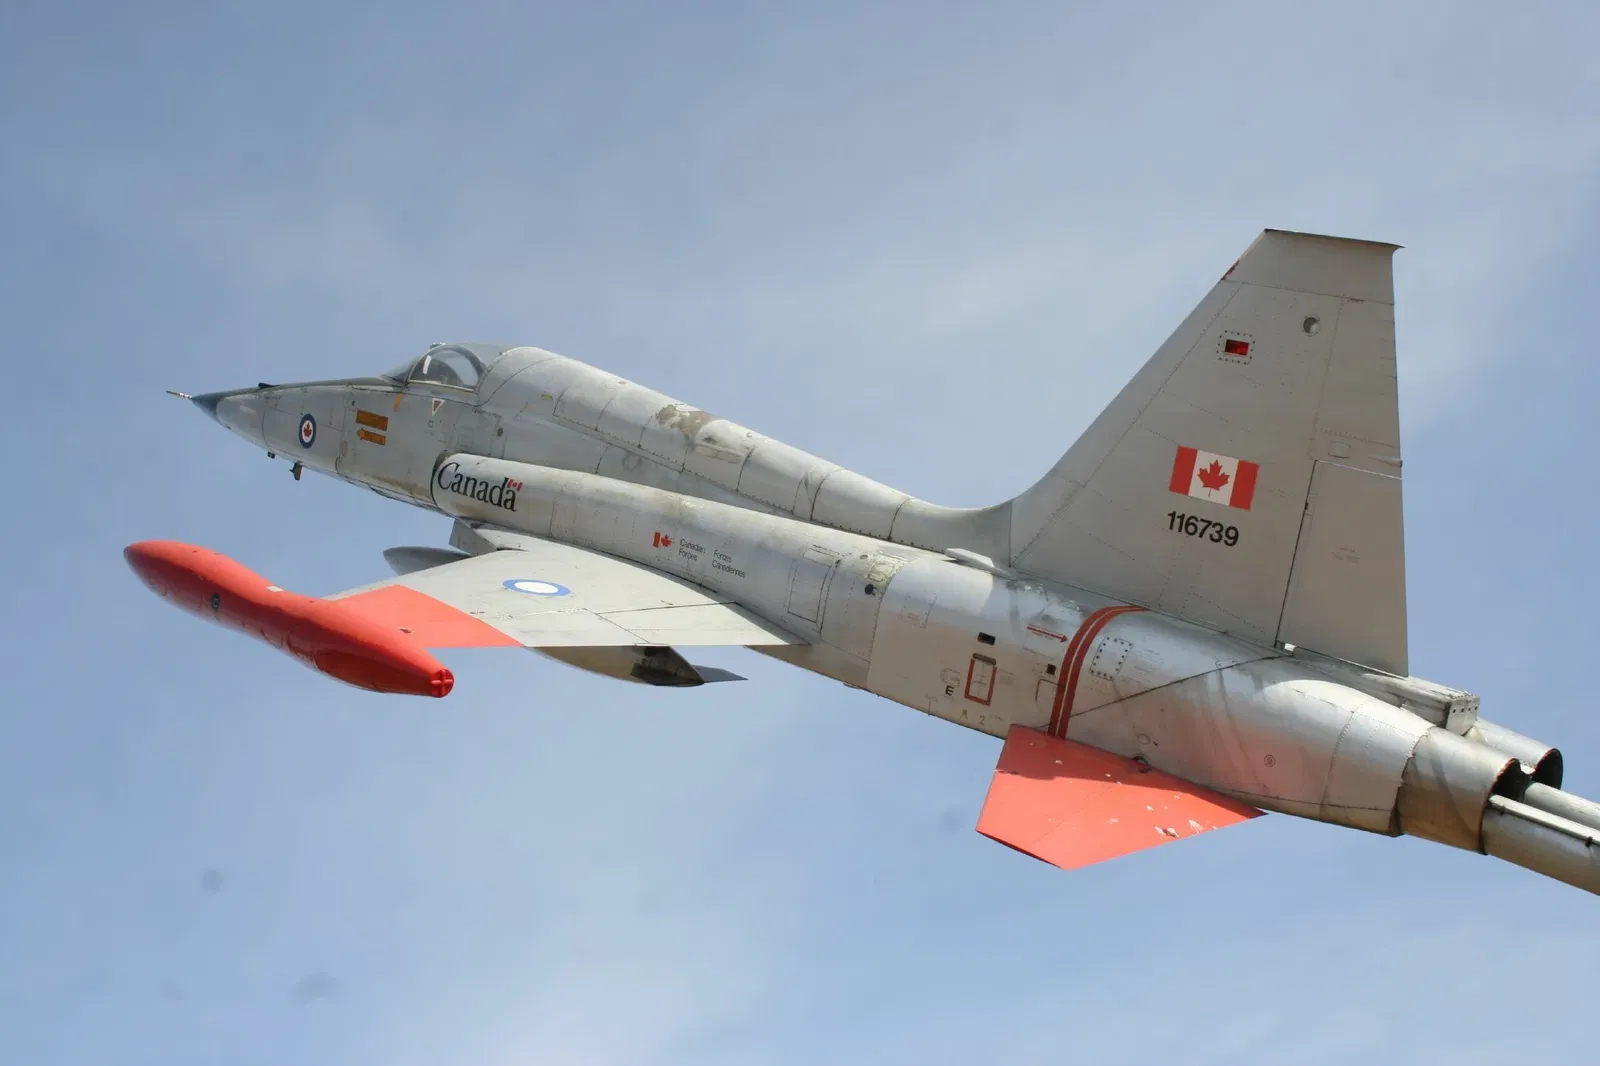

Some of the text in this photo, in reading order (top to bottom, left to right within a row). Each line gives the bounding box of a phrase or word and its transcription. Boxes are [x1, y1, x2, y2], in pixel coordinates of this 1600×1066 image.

[437, 461, 518, 513] Canada
[1167, 510, 1240, 547] 116739
[679, 538, 706, 554] Canadian
[678, 547, 698, 561] Forces
[712, 549, 732, 563] Forces
[944, 684, 955, 697] E
